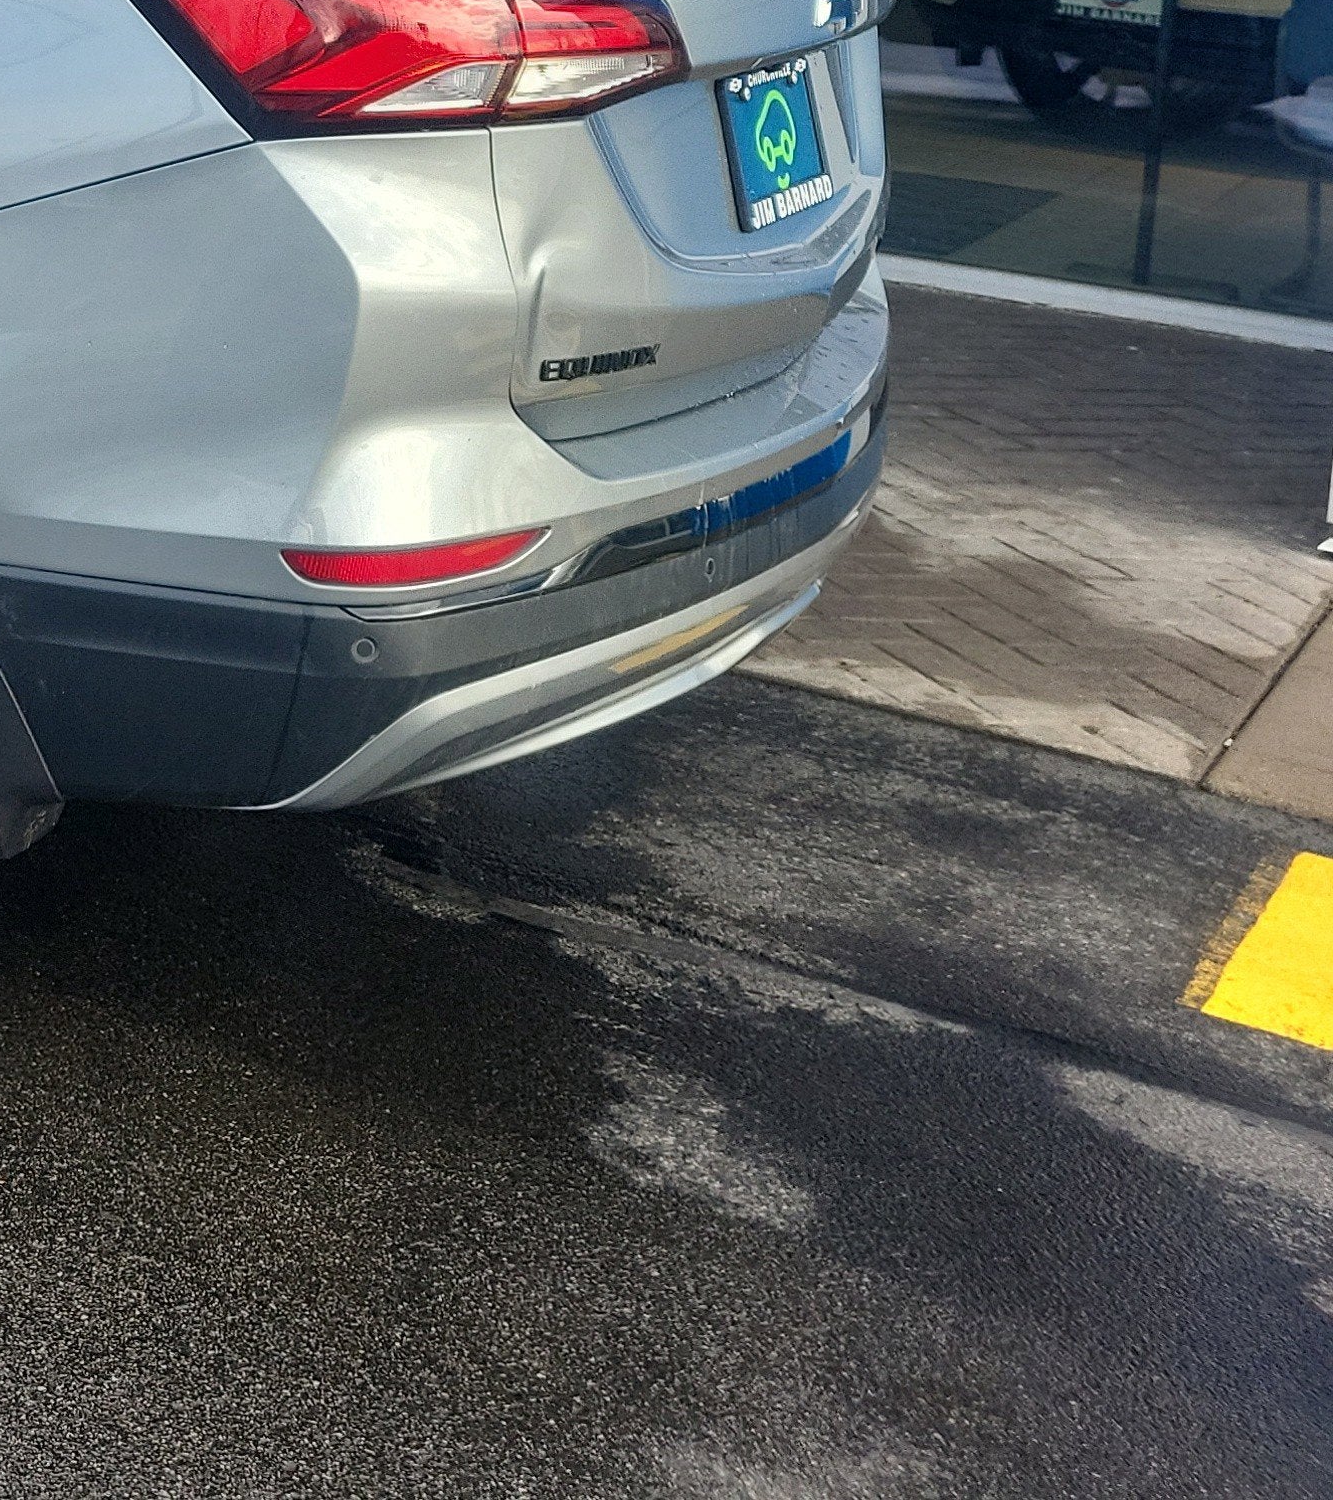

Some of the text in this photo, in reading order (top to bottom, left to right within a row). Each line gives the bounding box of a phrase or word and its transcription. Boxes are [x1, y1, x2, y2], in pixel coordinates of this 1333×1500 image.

[751, 174, 833, 230] JIM BARNARD
[539, 343, 661, 382] EQUINOX
